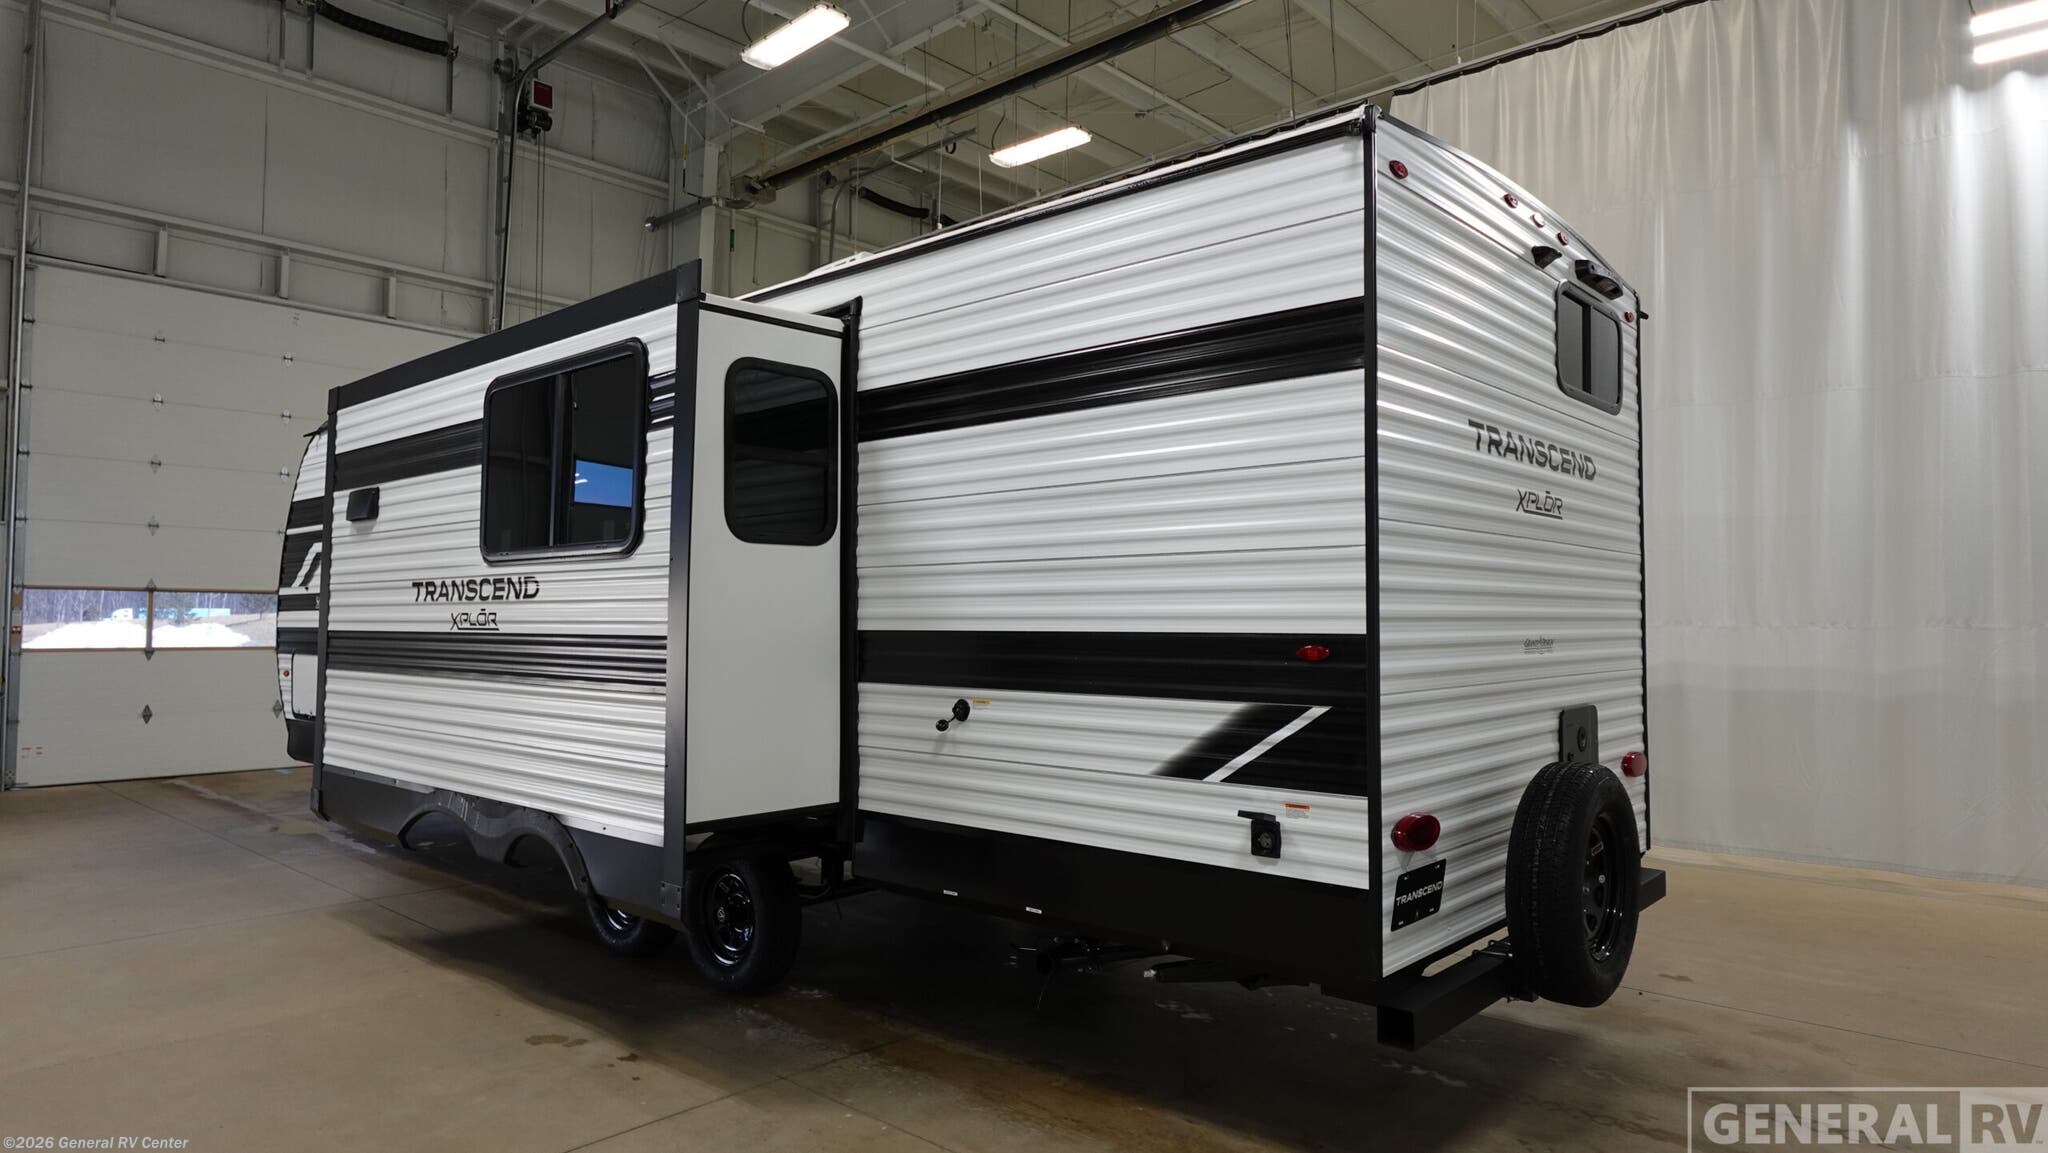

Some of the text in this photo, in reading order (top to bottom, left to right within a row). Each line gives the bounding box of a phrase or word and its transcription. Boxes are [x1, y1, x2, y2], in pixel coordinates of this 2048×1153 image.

[1468, 418, 1596, 481] TRANSCEND
[412, 576, 540, 602] TRANSCEND
[1396, 881, 1443, 907] TRANSCEND
